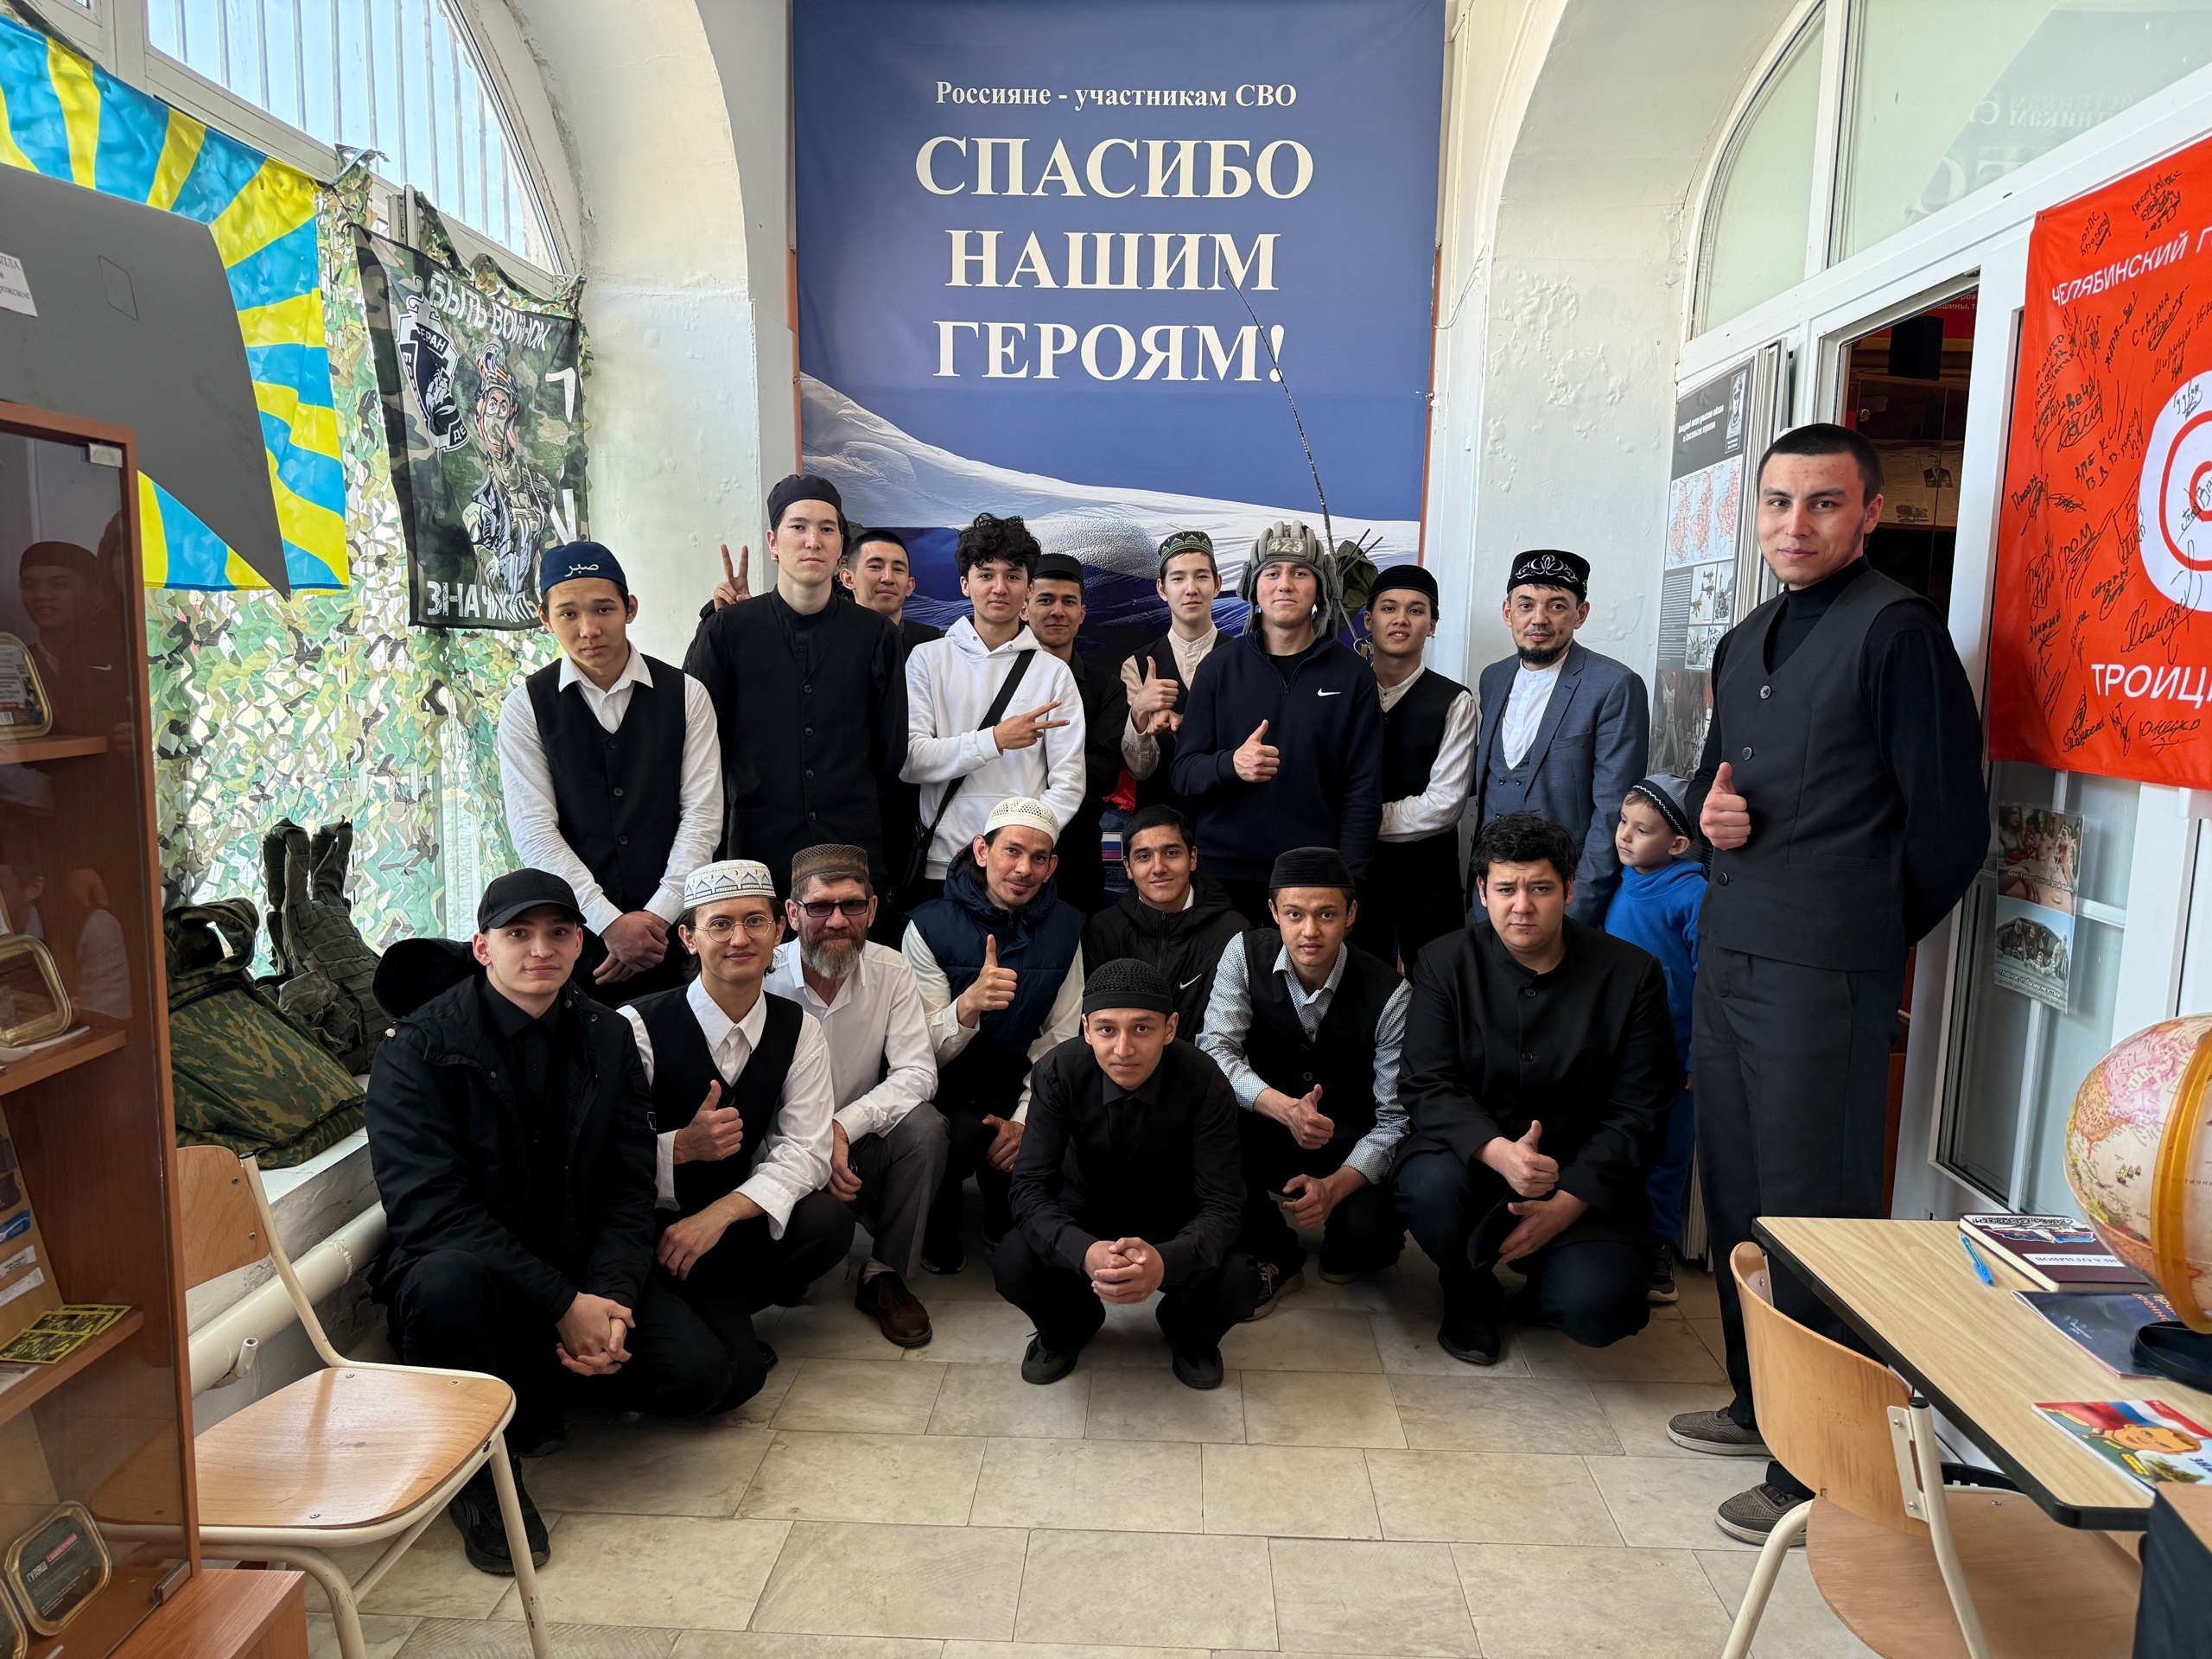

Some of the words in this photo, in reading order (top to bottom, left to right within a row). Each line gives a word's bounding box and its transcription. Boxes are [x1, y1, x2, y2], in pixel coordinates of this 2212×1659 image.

[936, 81, 1052, 105] Россияне
[1075, 87, 1227, 111] участникам
[1236, 84, 1297, 106] СВО
[915, 136, 1313, 199] СПАСИБО
[944, 229, 1281, 290] НАШИМ
[2052, 231, 2189, 307] ЧЕЛЯБИНСКИЙ
[2196, 226, 2212, 253] Г
[429, 270, 487, 328] БЫТЬ
[933, 321, 1285, 383] ГЕРОЯМ!
[564, 563, 599, 577] صبر
[1270, 539, 1304, 552] 423
[2091, 664, 2212, 709] ТРОИЦ
[26, 1560, 48, 1583] ГУЛЯШ
